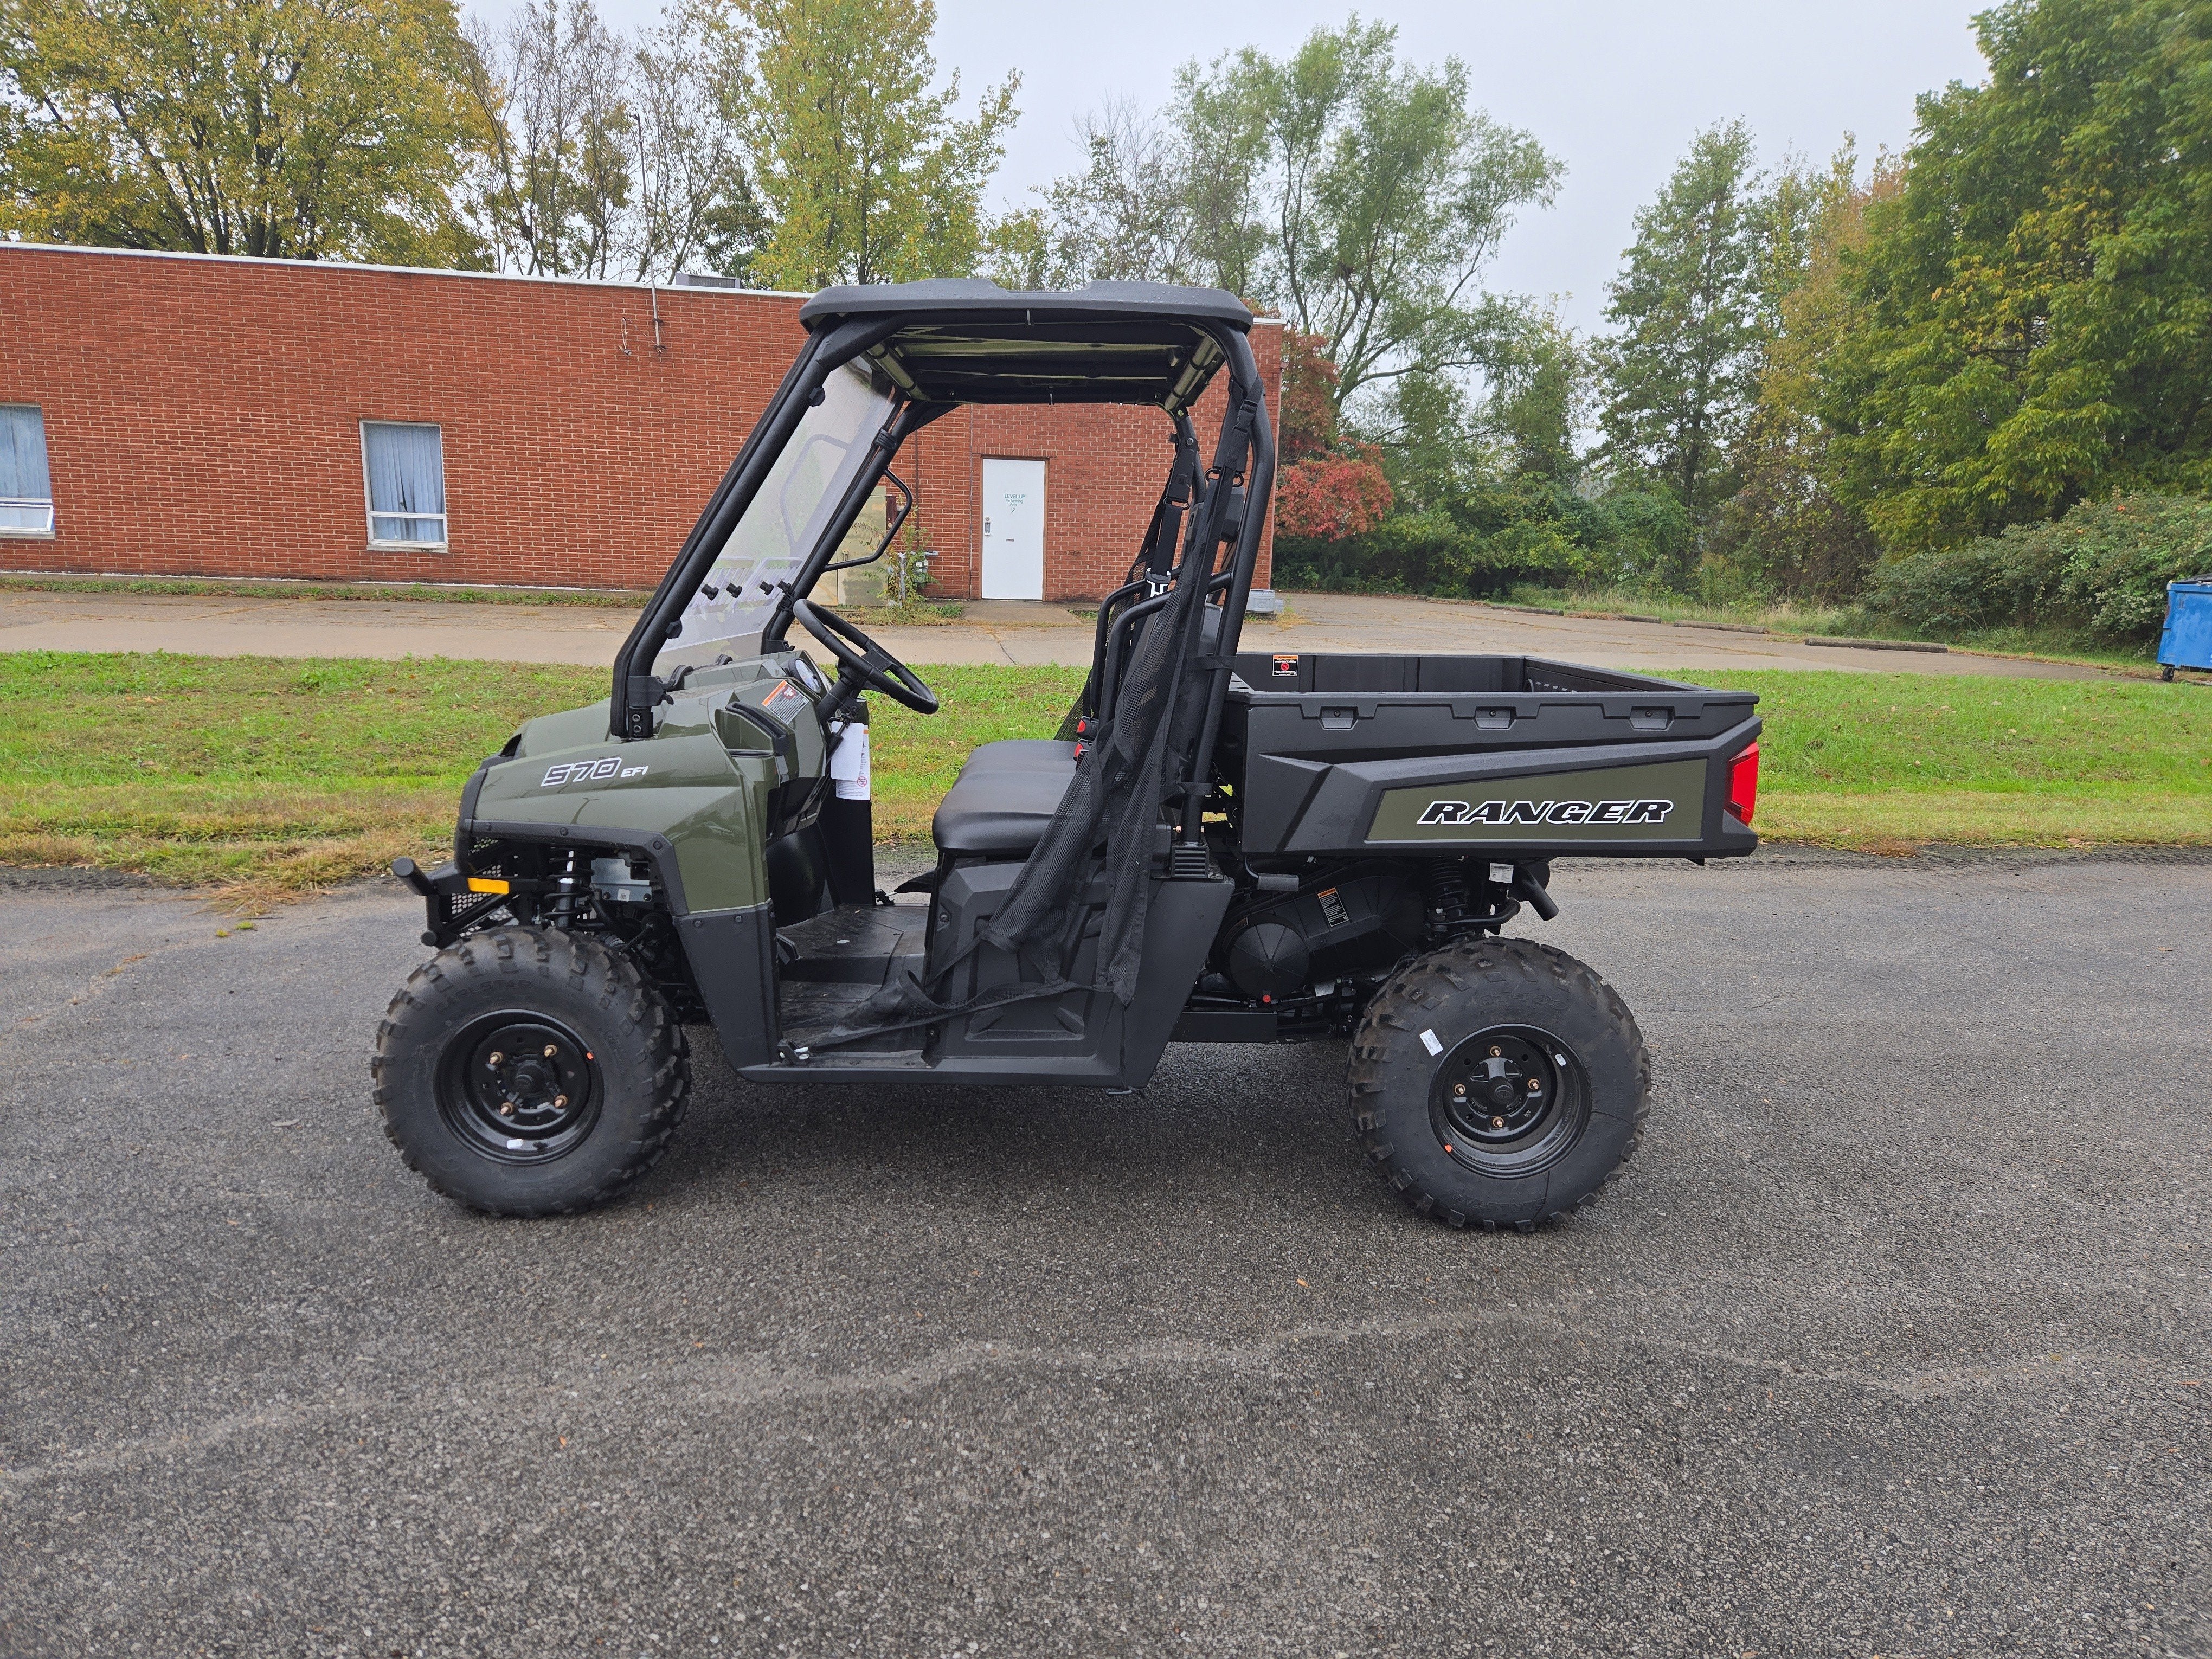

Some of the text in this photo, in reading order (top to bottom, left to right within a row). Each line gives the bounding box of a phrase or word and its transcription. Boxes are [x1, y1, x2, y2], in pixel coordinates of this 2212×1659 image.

[541, 757, 649, 787] 570 EFI
[1416, 800, 1674, 825] RANGER
